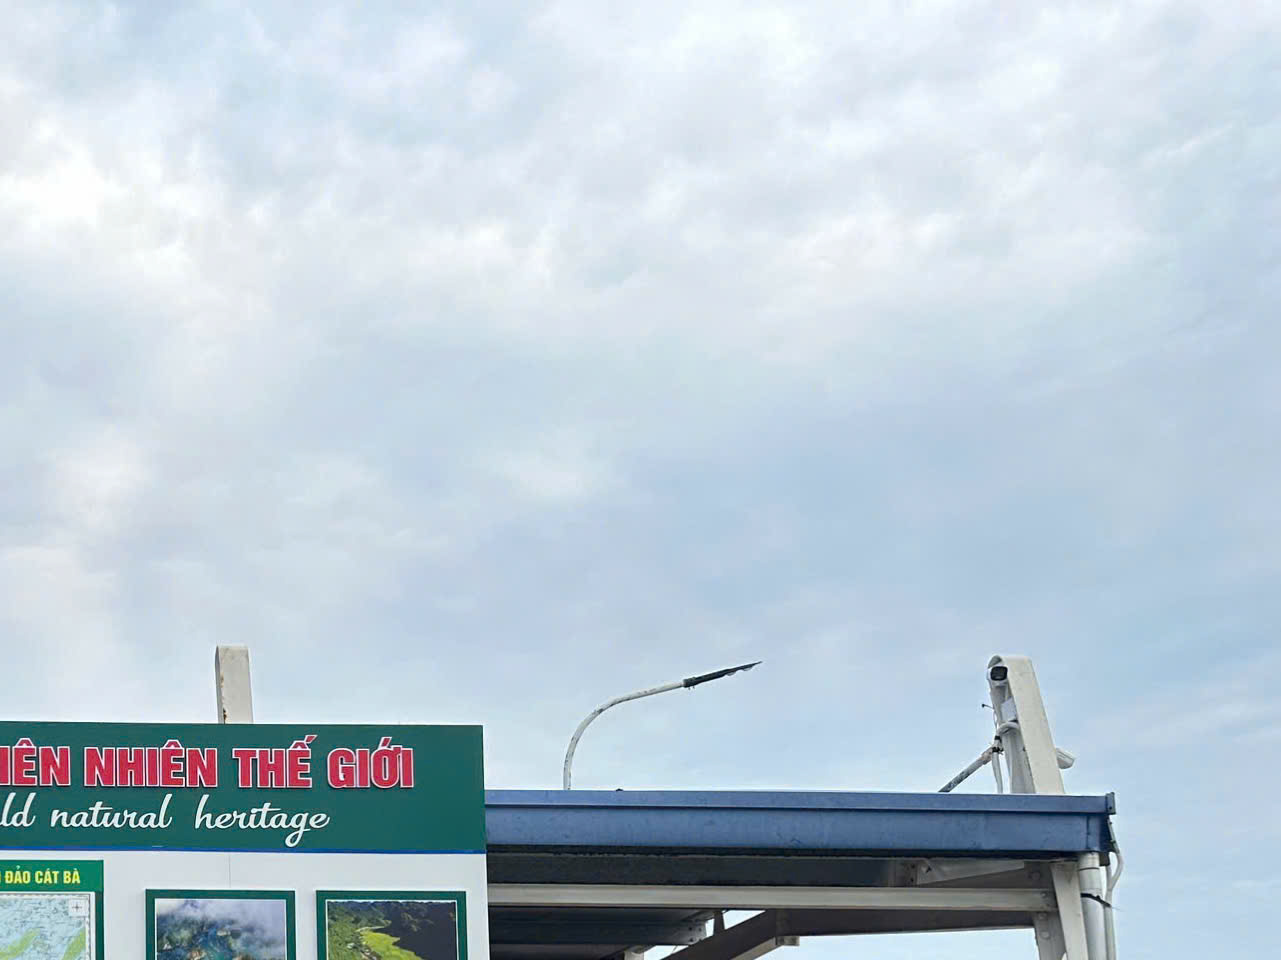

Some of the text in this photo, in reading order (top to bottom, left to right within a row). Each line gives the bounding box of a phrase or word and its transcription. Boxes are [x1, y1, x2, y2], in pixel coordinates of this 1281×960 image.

[84, 740, 218, 787] NHIÊN
[232, 735, 318, 788] THẾ
[327, 737, 414, 788] GIỚI
[51, 793, 173, 829] natural
[195, 794, 330, 848] heritage
[5, 864, 31, 884] ĐẢO
[35, 868, 59, 884] CÁT
[63, 868, 81, 884] BÀ
